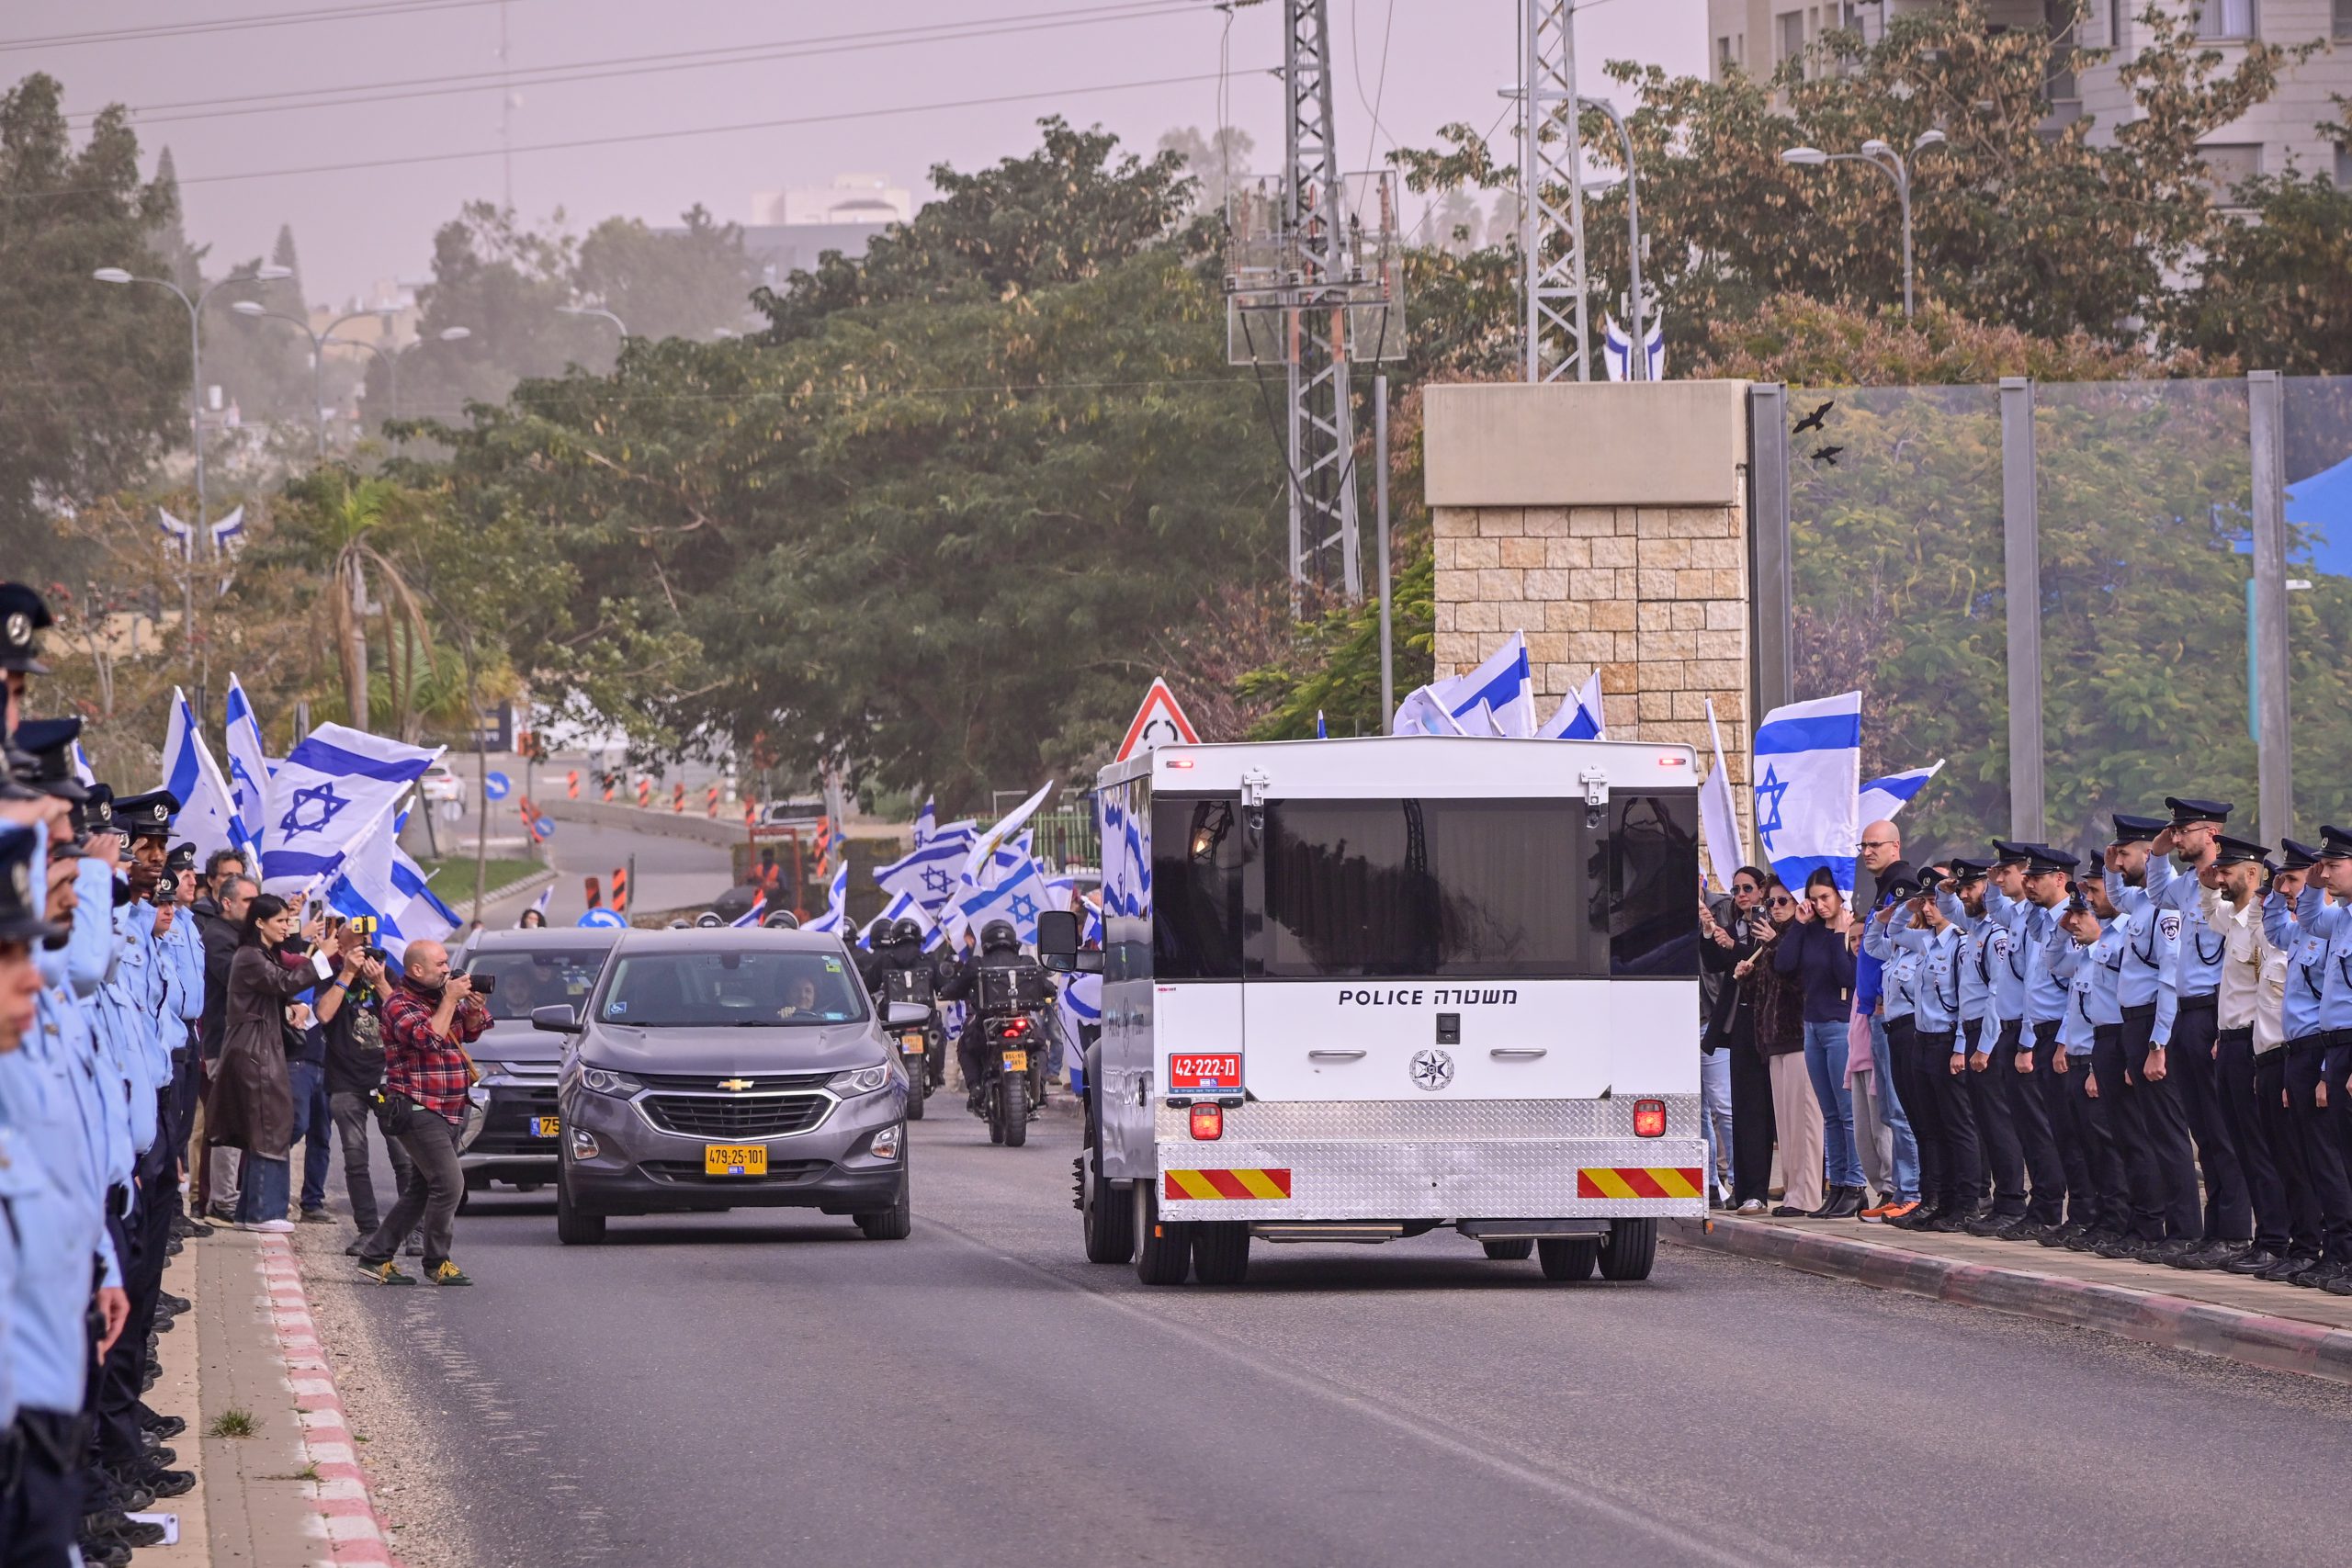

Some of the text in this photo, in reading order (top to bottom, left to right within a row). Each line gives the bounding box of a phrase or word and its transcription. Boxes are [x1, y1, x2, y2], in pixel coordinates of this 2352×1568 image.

[1339, 989, 1517, 1005] POLICE משטרה
[709, 1149, 763, 1164] 479-25-101
